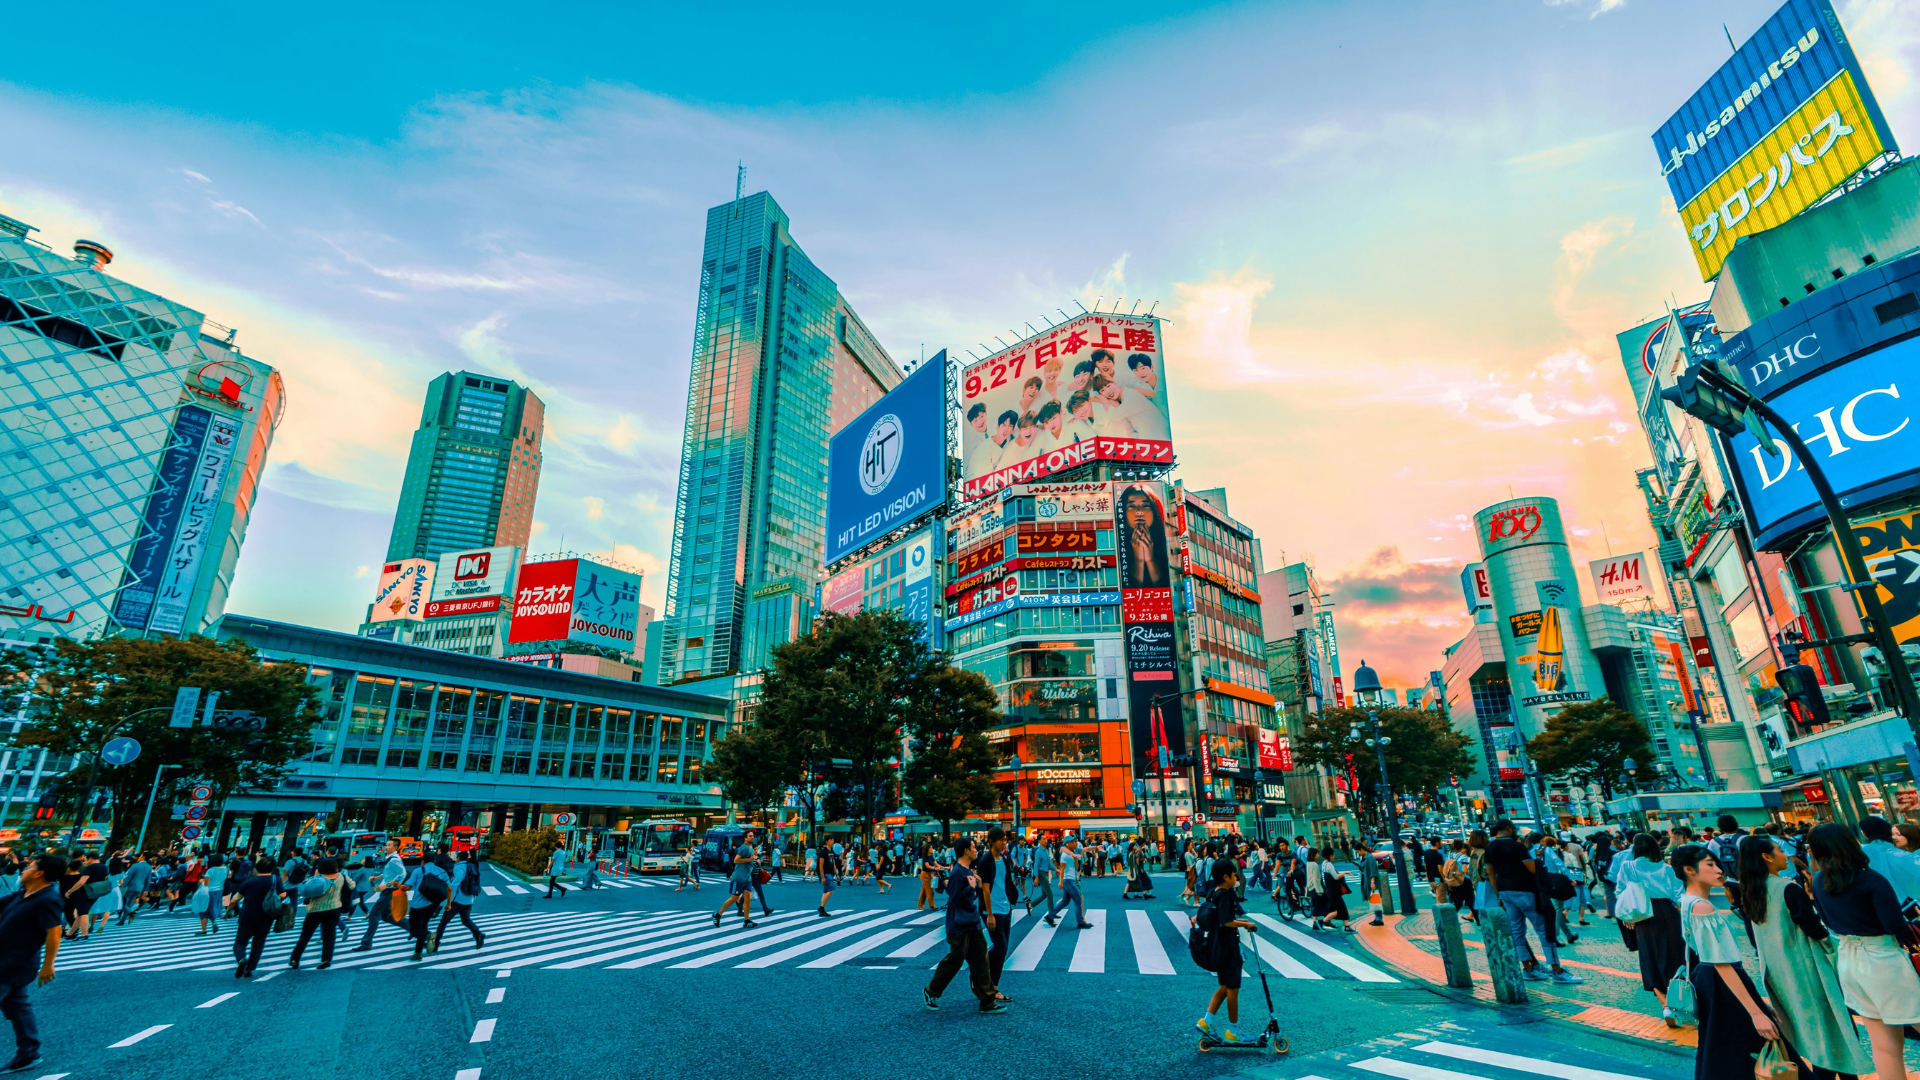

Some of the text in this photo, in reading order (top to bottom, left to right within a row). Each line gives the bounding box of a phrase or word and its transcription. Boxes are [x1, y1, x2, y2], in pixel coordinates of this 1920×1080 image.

[1661, 27, 1820, 177] Hisamitsu
[1690, 109, 1855, 250] サロンパス
[965, 325, 1156, 399] 9.27 日本上陸
[1749, 333, 1821, 386] DHC
[1749, 383, 1910, 490] DHC
[1100, 440, 1169, 457] ワナワン
[1027, 483, 1107, 494] しゃぶしゃぶバイキング
[1062, 497, 1110, 514] しゃぶ葉
[838, 484, 926, 548] HIT LED VISION
[163, 455, 220, 599] ワコールビッグバザール
[1487, 511, 1541, 542] 109
[948, 535, 957, 545] 9F
[1018, 533, 1094, 548] コンタクト
[457, 555, 487, 578] DC
[1071, 556, 1108, 570] ガスト
[908, 565, 929, 579] eyecity
[983, 565, 1007, 583] ガスト
[1599, 558, 1639, 586] H&M
[376, 566, 414, 604] SANKYO
[408, 564, 428, 615] SANKYO
[455, 585, 490, 595] MasterCard
[462, 580, 478, 588] VISA
[577, 572, 639, 607] 大声
[1608, 587, 1634, 597] 150m
[518, 584, 572, 604] カラオケ
[972, 586, 1001, 610] ガスト
[1051, 593, 1119, 605] 英会話イーオン
[1123, 588, 1171, 602] ユリゴコロ
[443, 600, 495, 612] 三菱東京UFJ銀行
[515, 601, 571, 618] JOYSOUND
[949, 603, 958, 614] 7F
[963, 603, 1004, 624] 英会話イーオン
[1129, 612, 1168, 621] 9.23公開
[1517, 618, 1542, 629] ガールズ
[571, 618, 634, 642] JOYSOUND
[1127, 626, 1171, 642] Rihwa
[1324, 615, 1337, 657] BIC CAMERA
[1131, 643, 1148, 652] 9.20
[1539, 663, 1558, 675] BIG
[1521, 692, 1590, 705] MAYBELLINE
[1262, 744, 1278, 756] アコム
[1037, 769, 1091, 779] L'OCCITANE
[1263, 783, 1285, 799] LUSH
